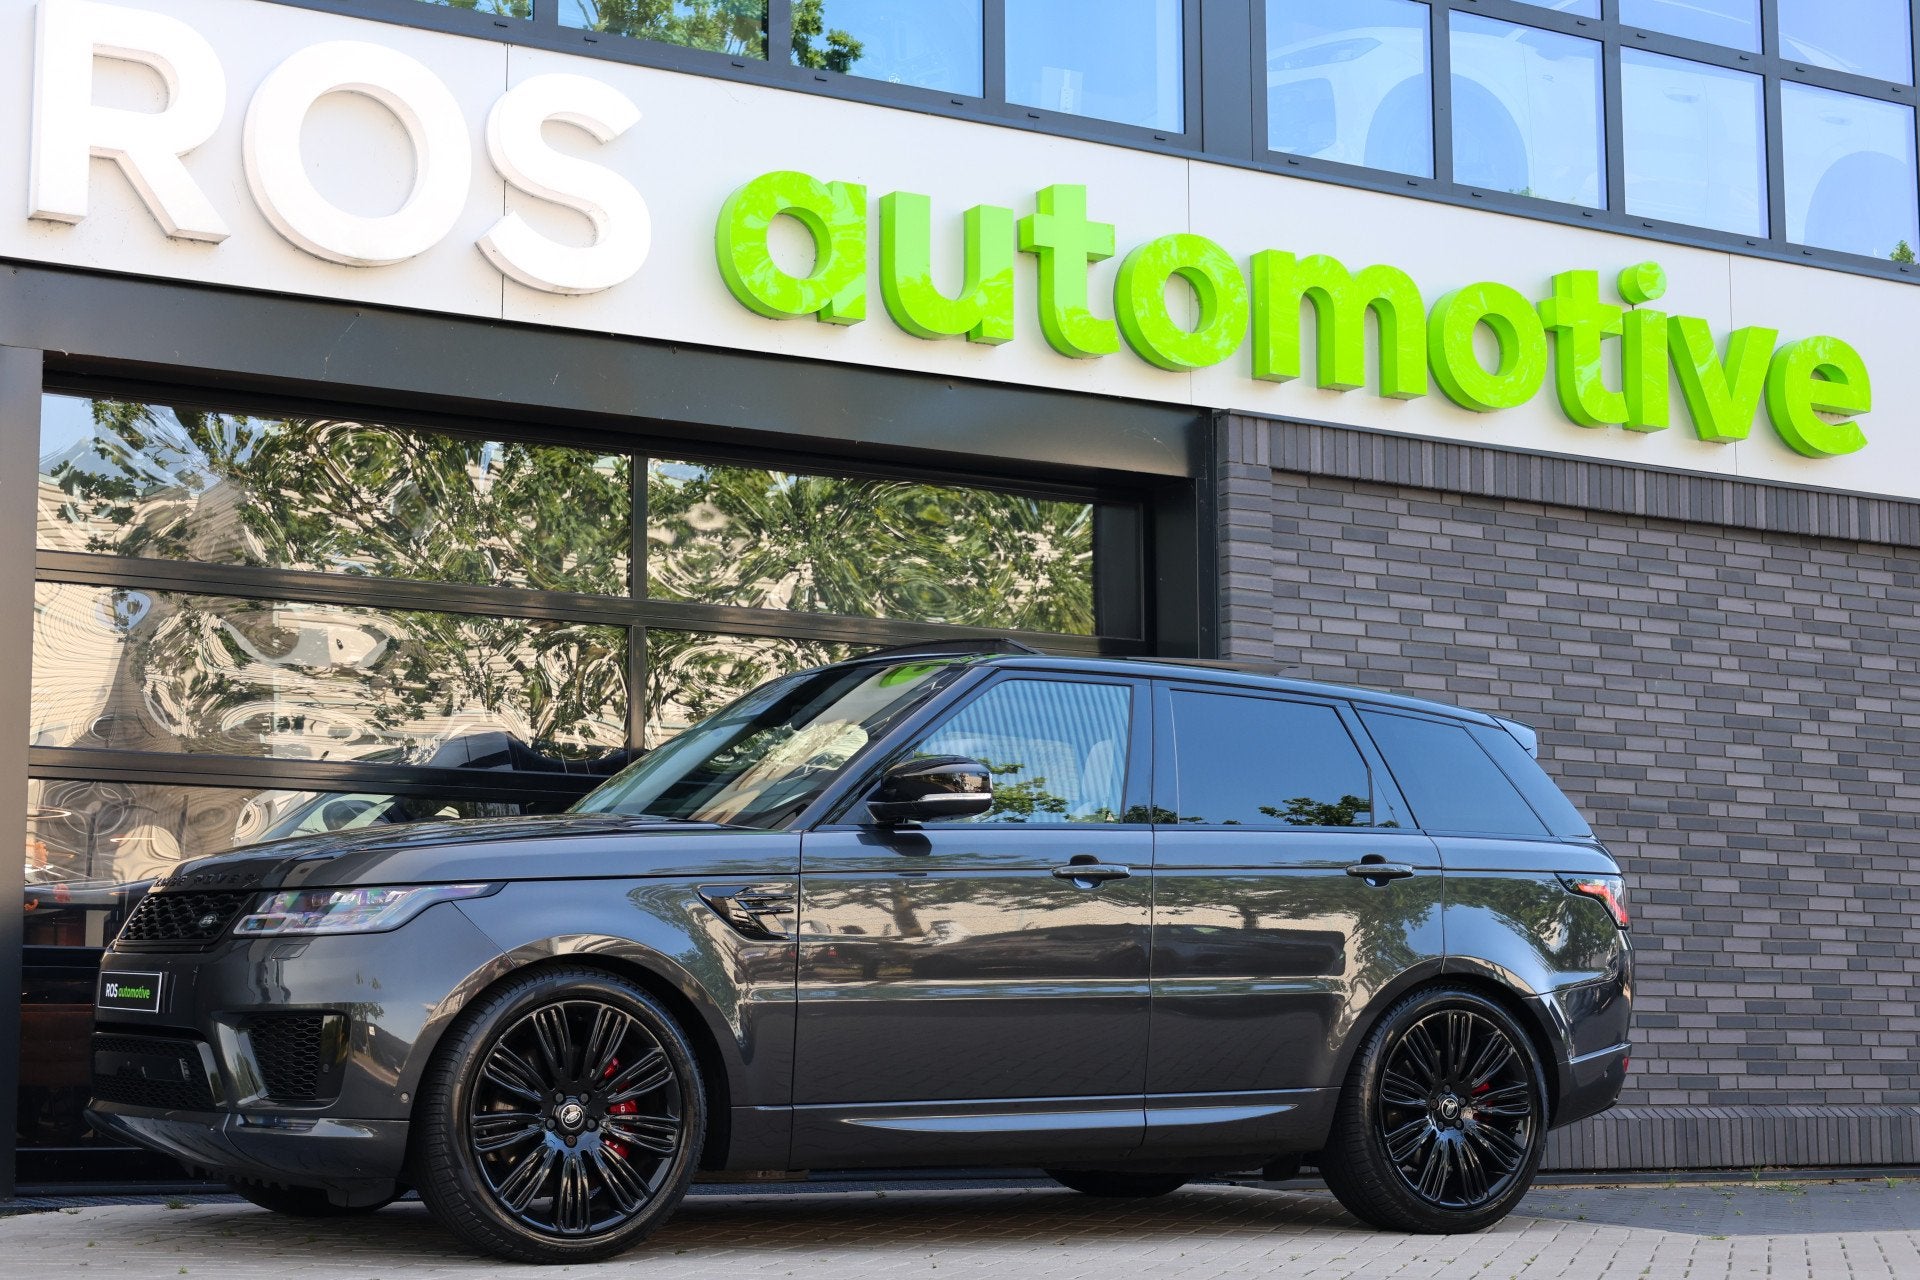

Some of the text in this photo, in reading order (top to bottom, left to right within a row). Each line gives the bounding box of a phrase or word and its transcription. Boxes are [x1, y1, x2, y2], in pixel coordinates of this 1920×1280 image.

[27, 0, 1873, 459] ROS automotive
[105, 983, 151, 999] ROS automotive
